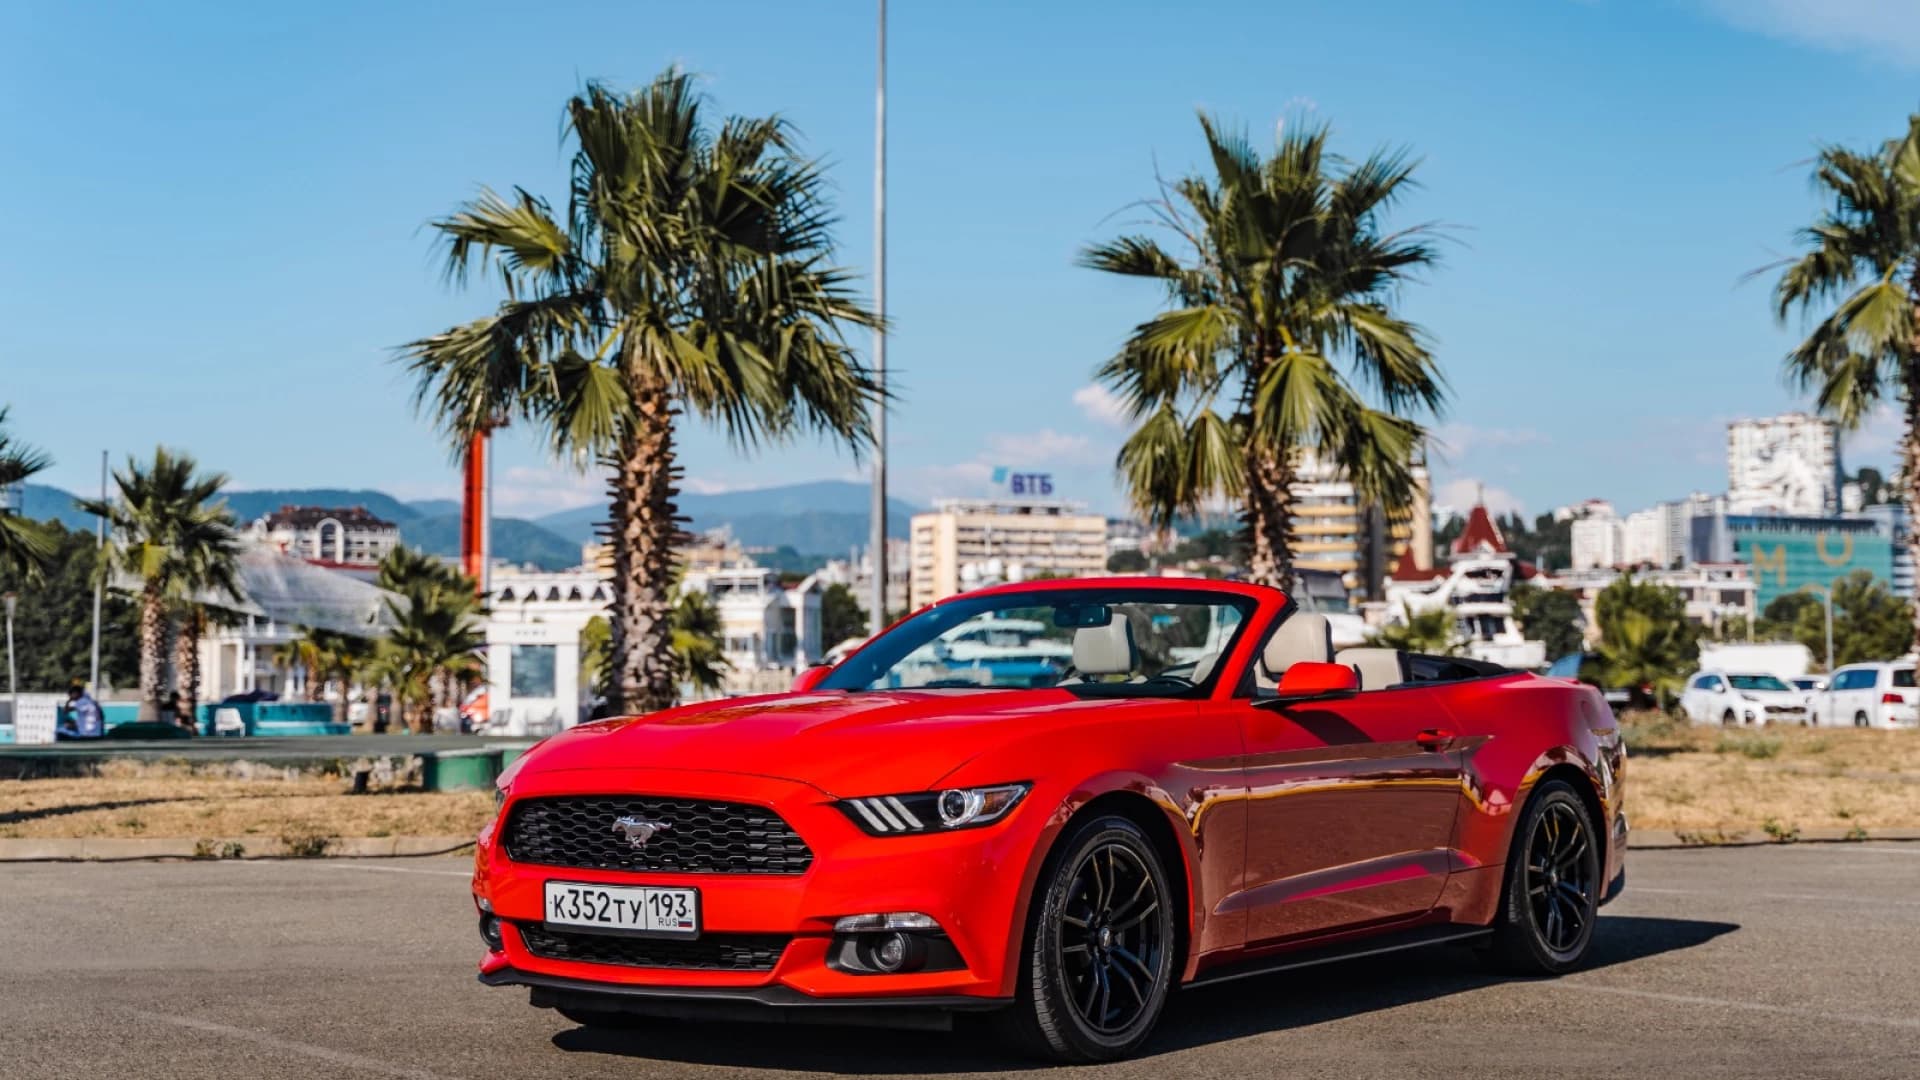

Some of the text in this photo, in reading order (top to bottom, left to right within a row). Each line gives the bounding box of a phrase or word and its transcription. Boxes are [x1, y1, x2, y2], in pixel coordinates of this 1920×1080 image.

[1011, 473, 1053, 495] ВТБ
[649, 893, 687, 917] 193
[658, 917, 677, 926] RUS
